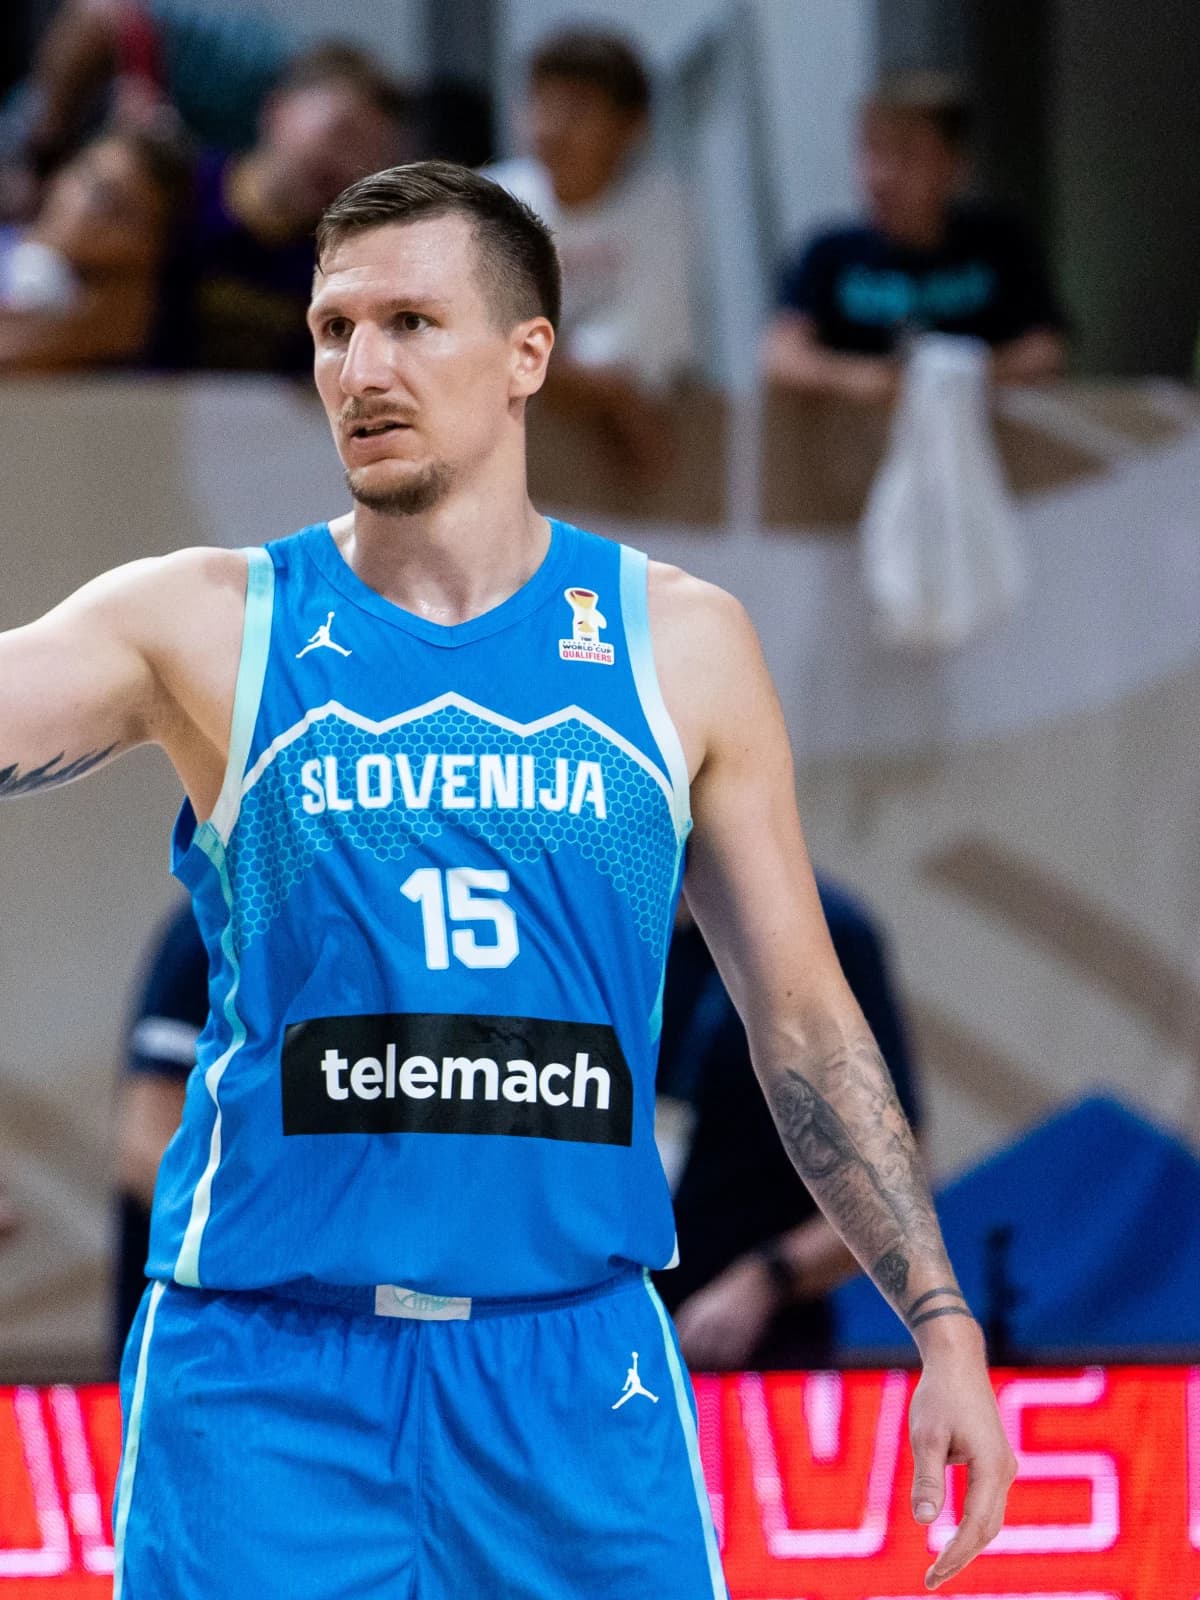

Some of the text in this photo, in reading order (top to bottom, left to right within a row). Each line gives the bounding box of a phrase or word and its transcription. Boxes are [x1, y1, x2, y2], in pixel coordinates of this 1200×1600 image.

[562, 644, 593, 652] WORLD
[595, 646, 612, 654] CUP
[562, 650, 612, 662] QUALIFIERS
[302, 753, 607, 820] SLOVENIJA
[400, 866, 520, 970] 15
[321, 1043, 611, 1110] telemach
